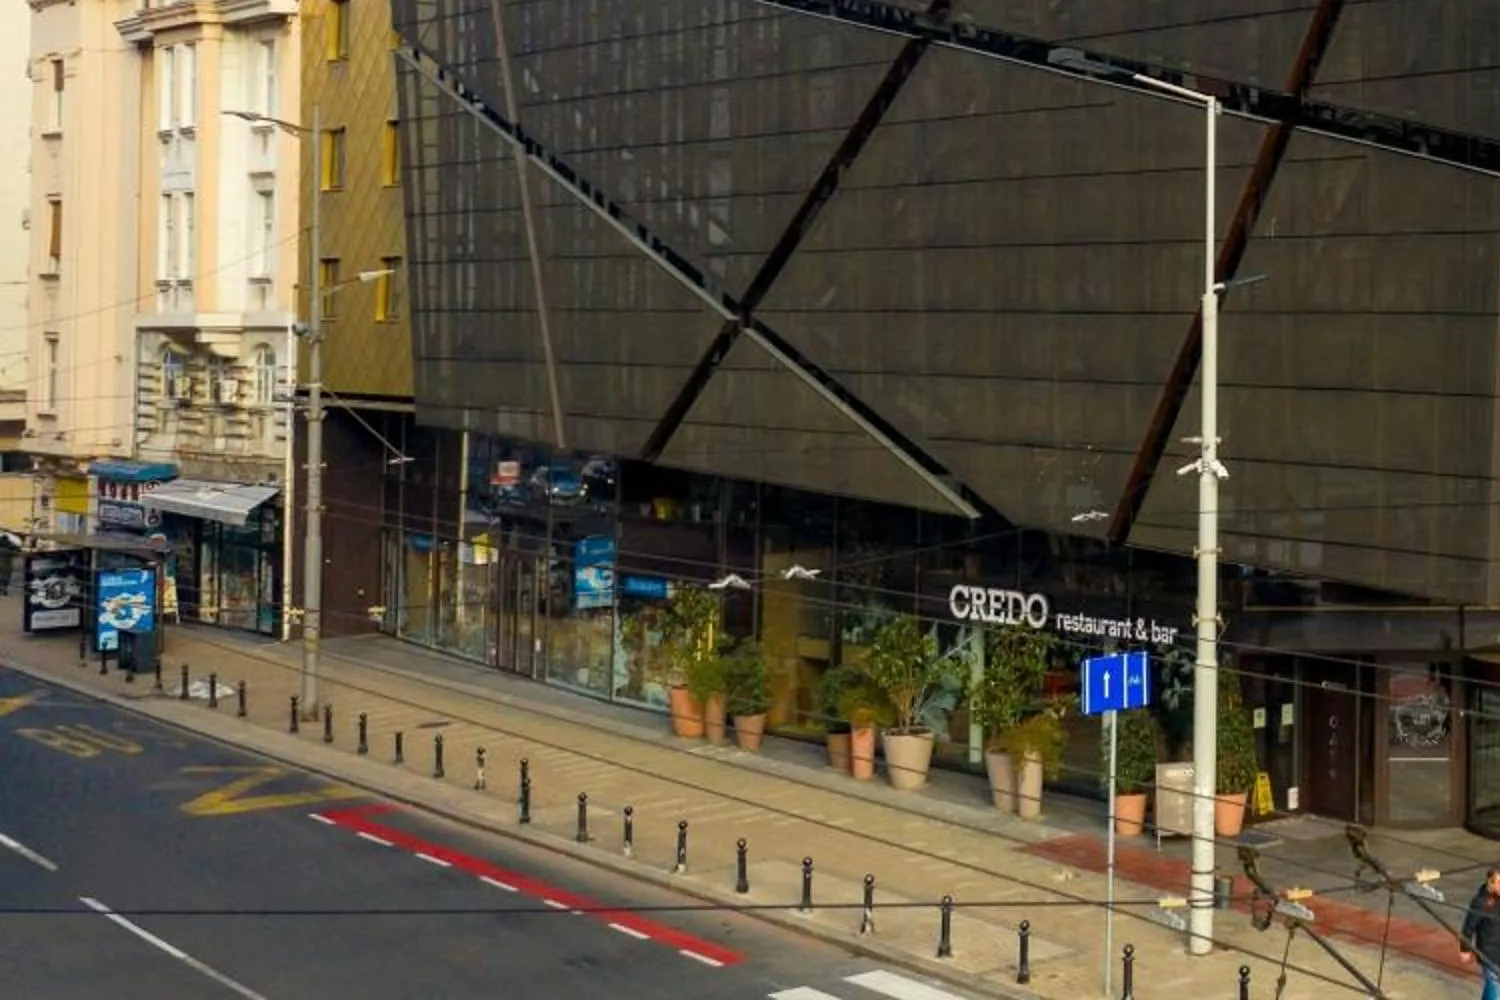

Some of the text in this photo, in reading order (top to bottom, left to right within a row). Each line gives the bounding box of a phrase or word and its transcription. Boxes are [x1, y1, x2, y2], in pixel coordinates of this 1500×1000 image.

[950, 584, 1178, 645] CREDO restaurant & bar
